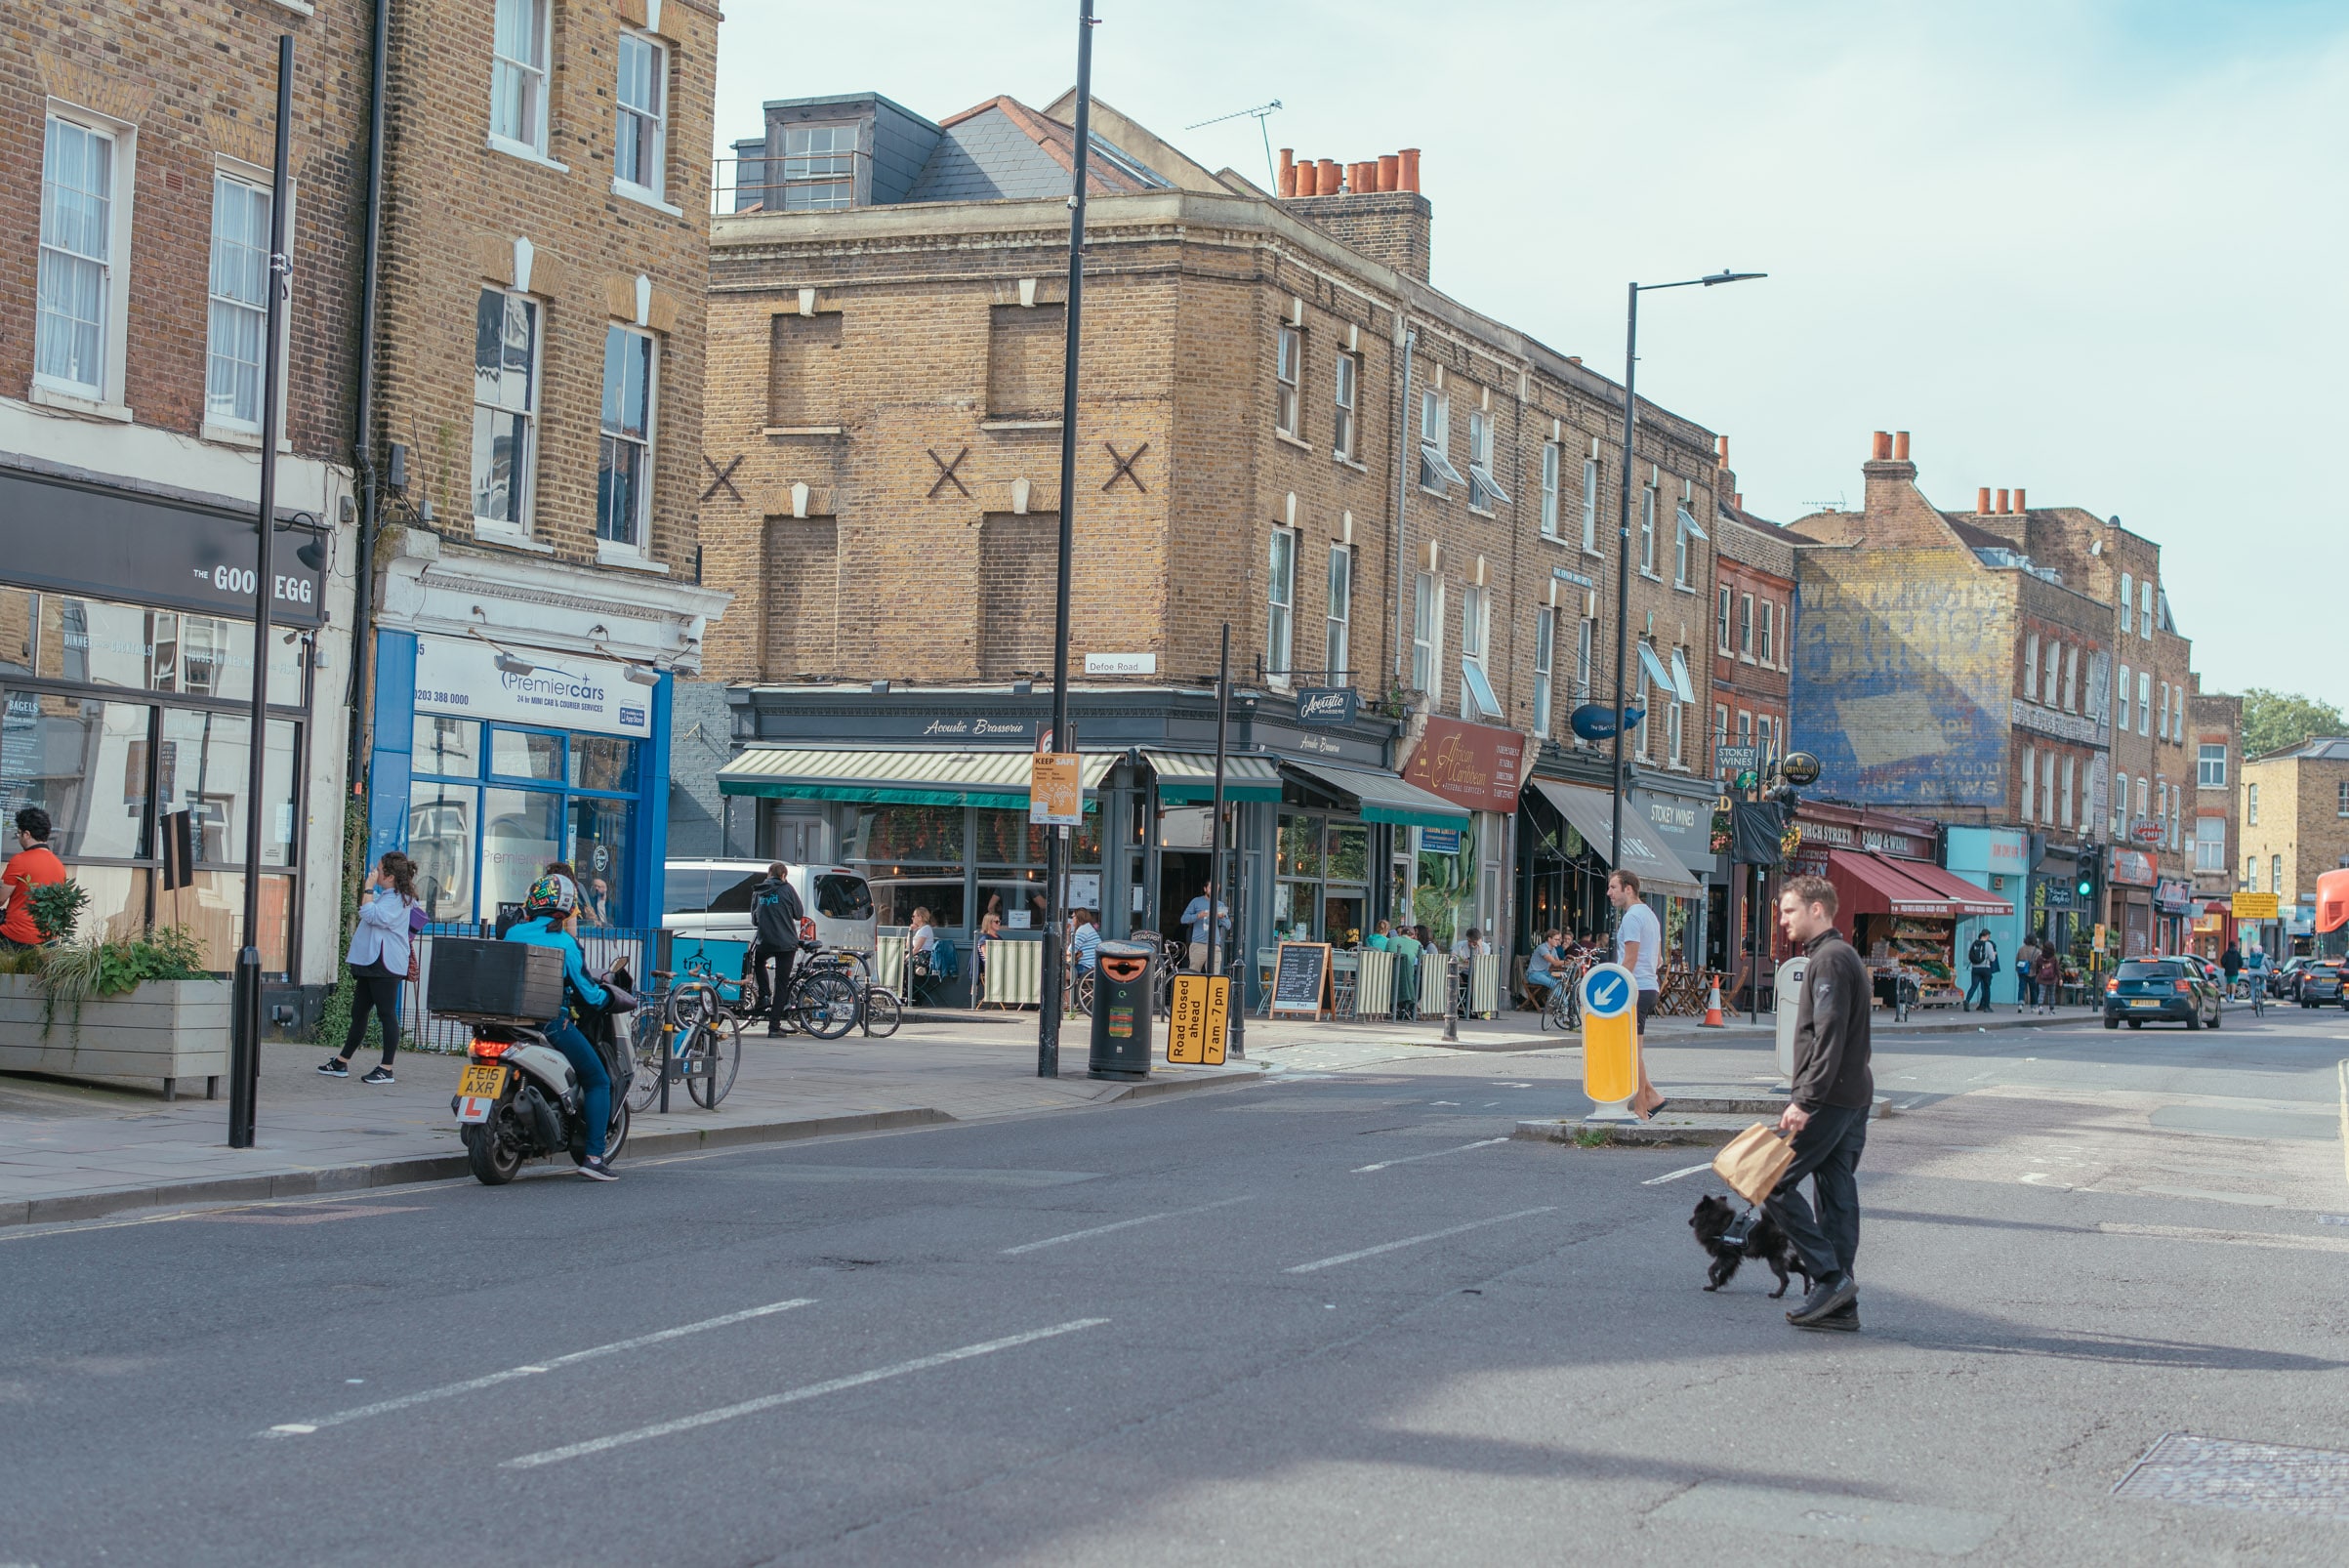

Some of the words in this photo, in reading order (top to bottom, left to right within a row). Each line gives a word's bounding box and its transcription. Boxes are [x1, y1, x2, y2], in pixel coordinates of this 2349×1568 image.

[193, 569, 209, 579] THE
[214, 565, 258, 595] GOO
[274, 575, 311, 603] EGG
[64, 634, 94, 649] DINNER
[186, 649, 211, 664] HOUSE
[1090, 662, 1114, 671] Defoe
[1117, 662, 1138, 671] Road
[509, 672, 604, 701] Premiercars
[9, 699, 39, 713] BAGELS
[433, 691, 449, 703] 388
[450, 693, 469, 705] 0000
[531, 696, 543, 705] MINI
[544, 698, 554, 707] CAB
[559, 700, 581, 710] COURIER
[581, 703, 603, 713] SERVICES
[1300, 693, 1343, 718] Acoustic
[923, 719, 968, 735] Acoustic
[972, 719, 1023, 735] Brasserie
[1718, 748, 1754, 757] STOKEY
[1055, 758, 1075, 766] SAFE
[1720, 758, 1752, 766] WINES
[1786, 765, 1815, 774] GUINNESS
[1452, 763, 1486, 786] Caribbean
[1651, 804, 1674, 824] STOKEY
[1675, 808, 1695, 827] WINES
[1823, 827, 1852, 845] STREET
[1862, 831, 1882, 846] FOOD
[1883, 835, 1889, 846] &
[1889, 836, 1908, 851] WINE
[759, 893, 779, 906] tryd
[1177, 980, 1189, 1020] closed
[1215, 987, 1224, 1006] pm
[1189, 1001, 1201, 1038] ahead
[1174, 1025, 1185, 1056] Road
[1212, 1026, 1220, 1044] am
[467, 1067, 500, 1081] FE16
[465, 1081, 495, 1093] AXR
[465, 1097, 482, 1117] L
